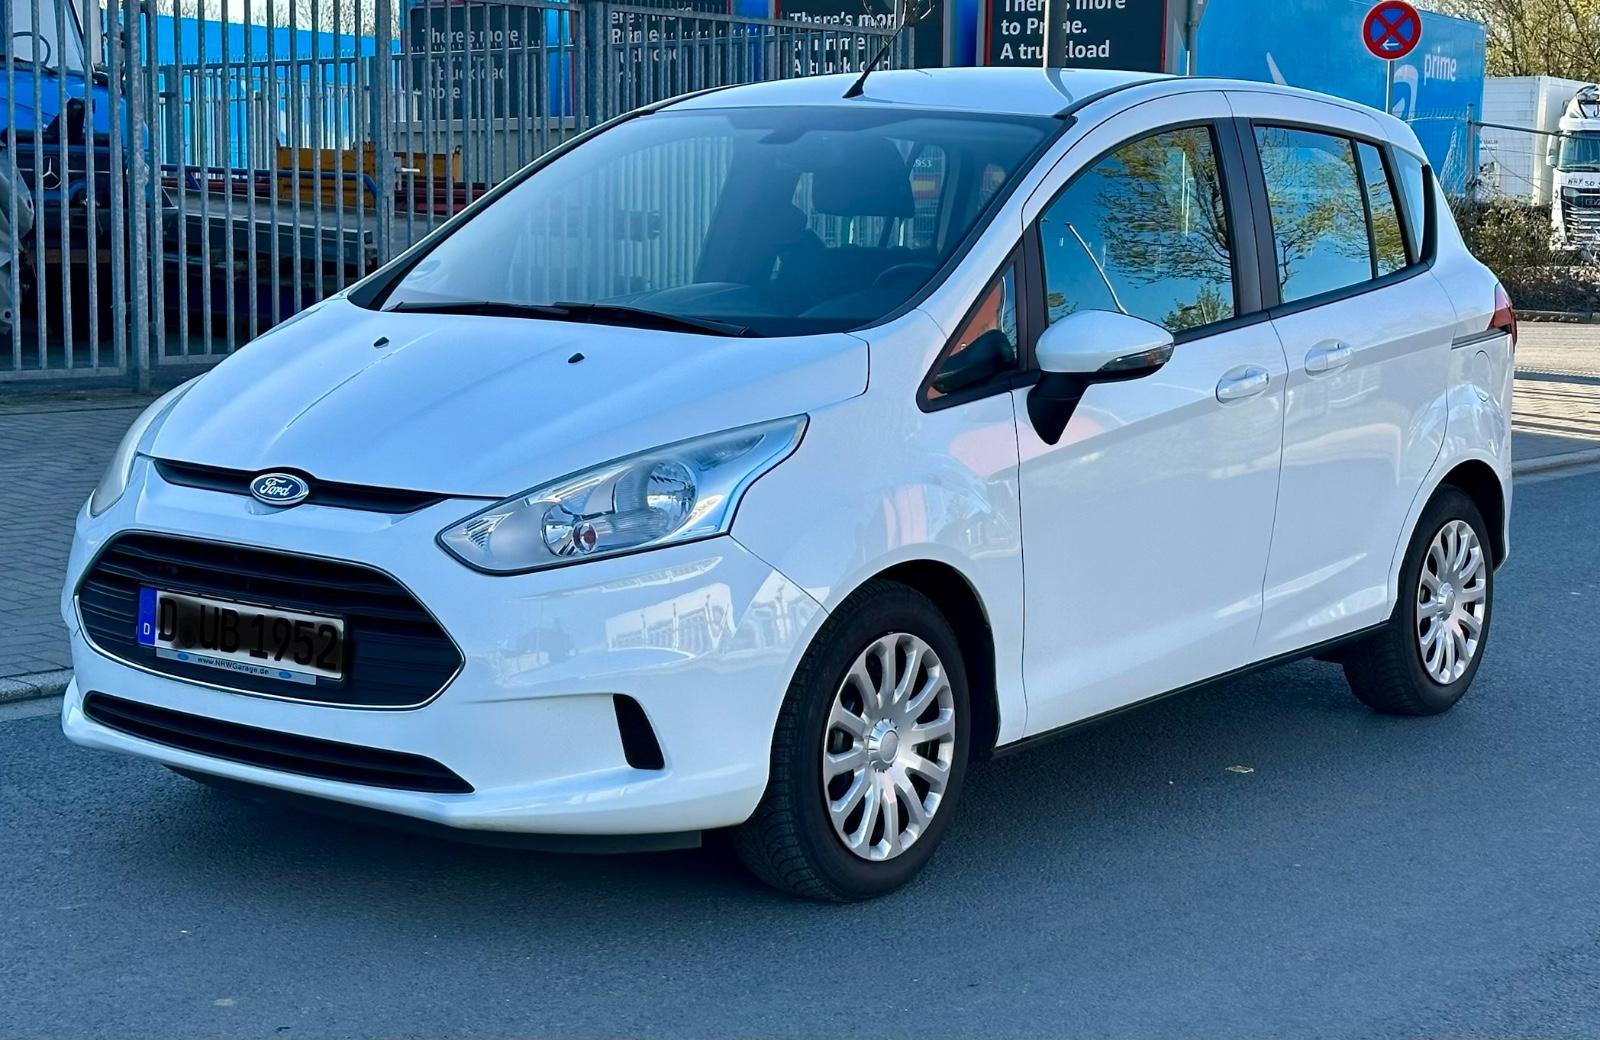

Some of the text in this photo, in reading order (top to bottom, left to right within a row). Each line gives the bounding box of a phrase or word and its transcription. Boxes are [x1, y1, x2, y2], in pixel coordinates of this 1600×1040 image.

[1001, 19, 1021, 35] to
[1000, 42, 1014, 59] A
[1423, 46, 1457, 86] prime
[259, 477, 293, 497] Ford
[143, 622, 150, 635] D
[158, 597, 177, 642] D
[249, 614, 338, 670] 1952
[197, 656, 270, 675] www.NRWGarage.de
